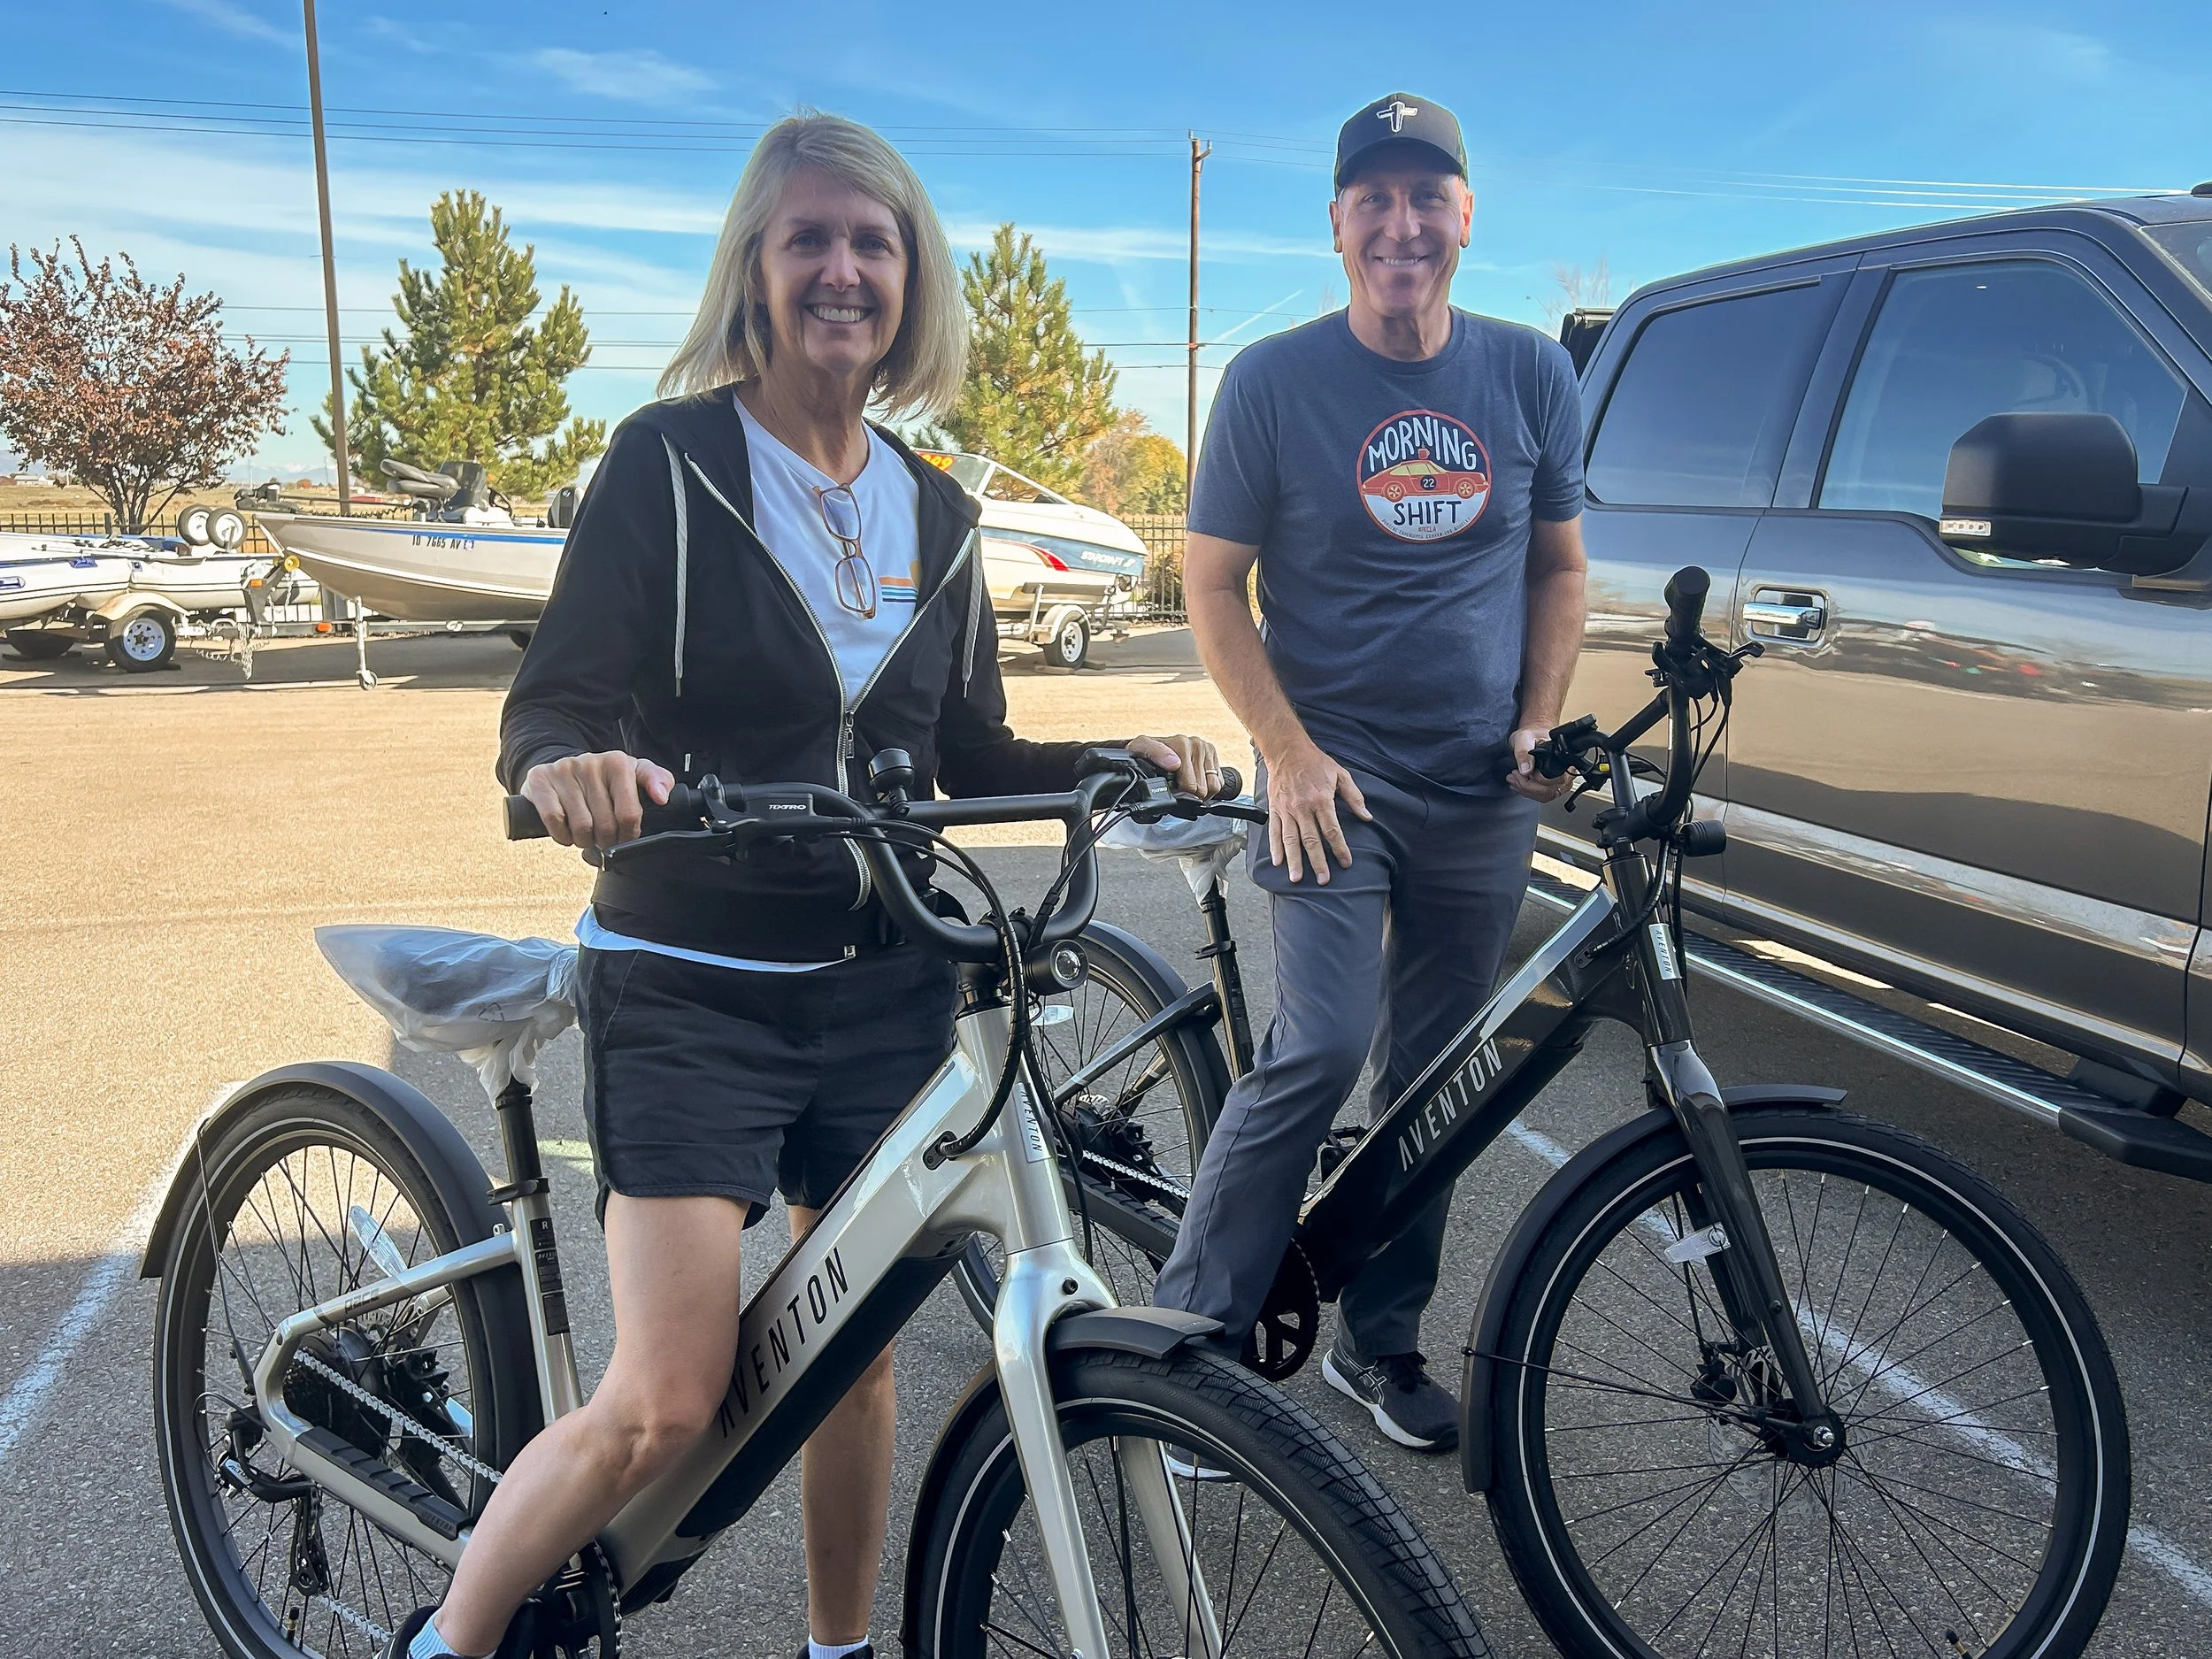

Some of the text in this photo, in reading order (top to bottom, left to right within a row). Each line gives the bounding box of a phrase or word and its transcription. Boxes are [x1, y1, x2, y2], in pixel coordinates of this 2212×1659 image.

[1368, 416, 1476, 472] MORNING
[1423, 479, 1435, 488] 22
[1393, 500, 1463, 526] SHIFT
[1655, 930, 1672, 973] AVENTON
[1020, 1090, 1042, 1151] AVENTON
[1398, 1037, 1502, 1171] AVENTON
[720, 1247, 849, 1438] AVENTON
